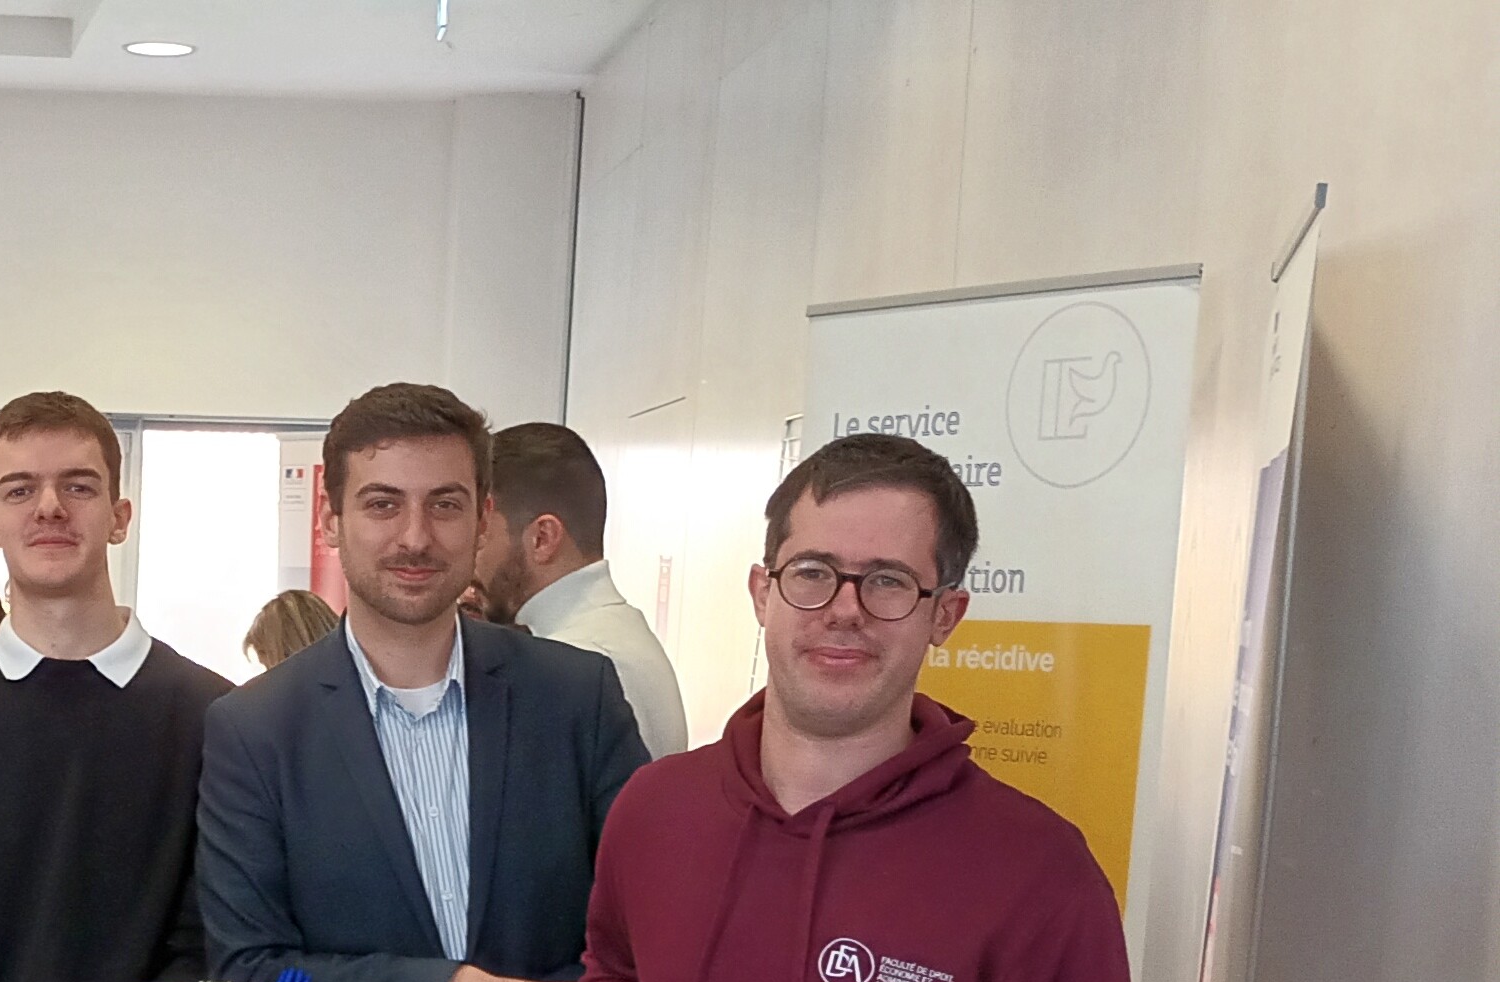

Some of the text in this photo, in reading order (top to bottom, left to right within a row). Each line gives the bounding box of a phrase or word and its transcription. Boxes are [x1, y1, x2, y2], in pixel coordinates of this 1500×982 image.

[833, 405, 960, 439] Le service
[928, 643, 1055, 672] la récidive
[982, 717, 1062, 738] évaluation
[1000, 747, 1048, 764] suivie
[881, 956, 917, 972] FACULTÉ
[916, 965, 929, 976] DE
